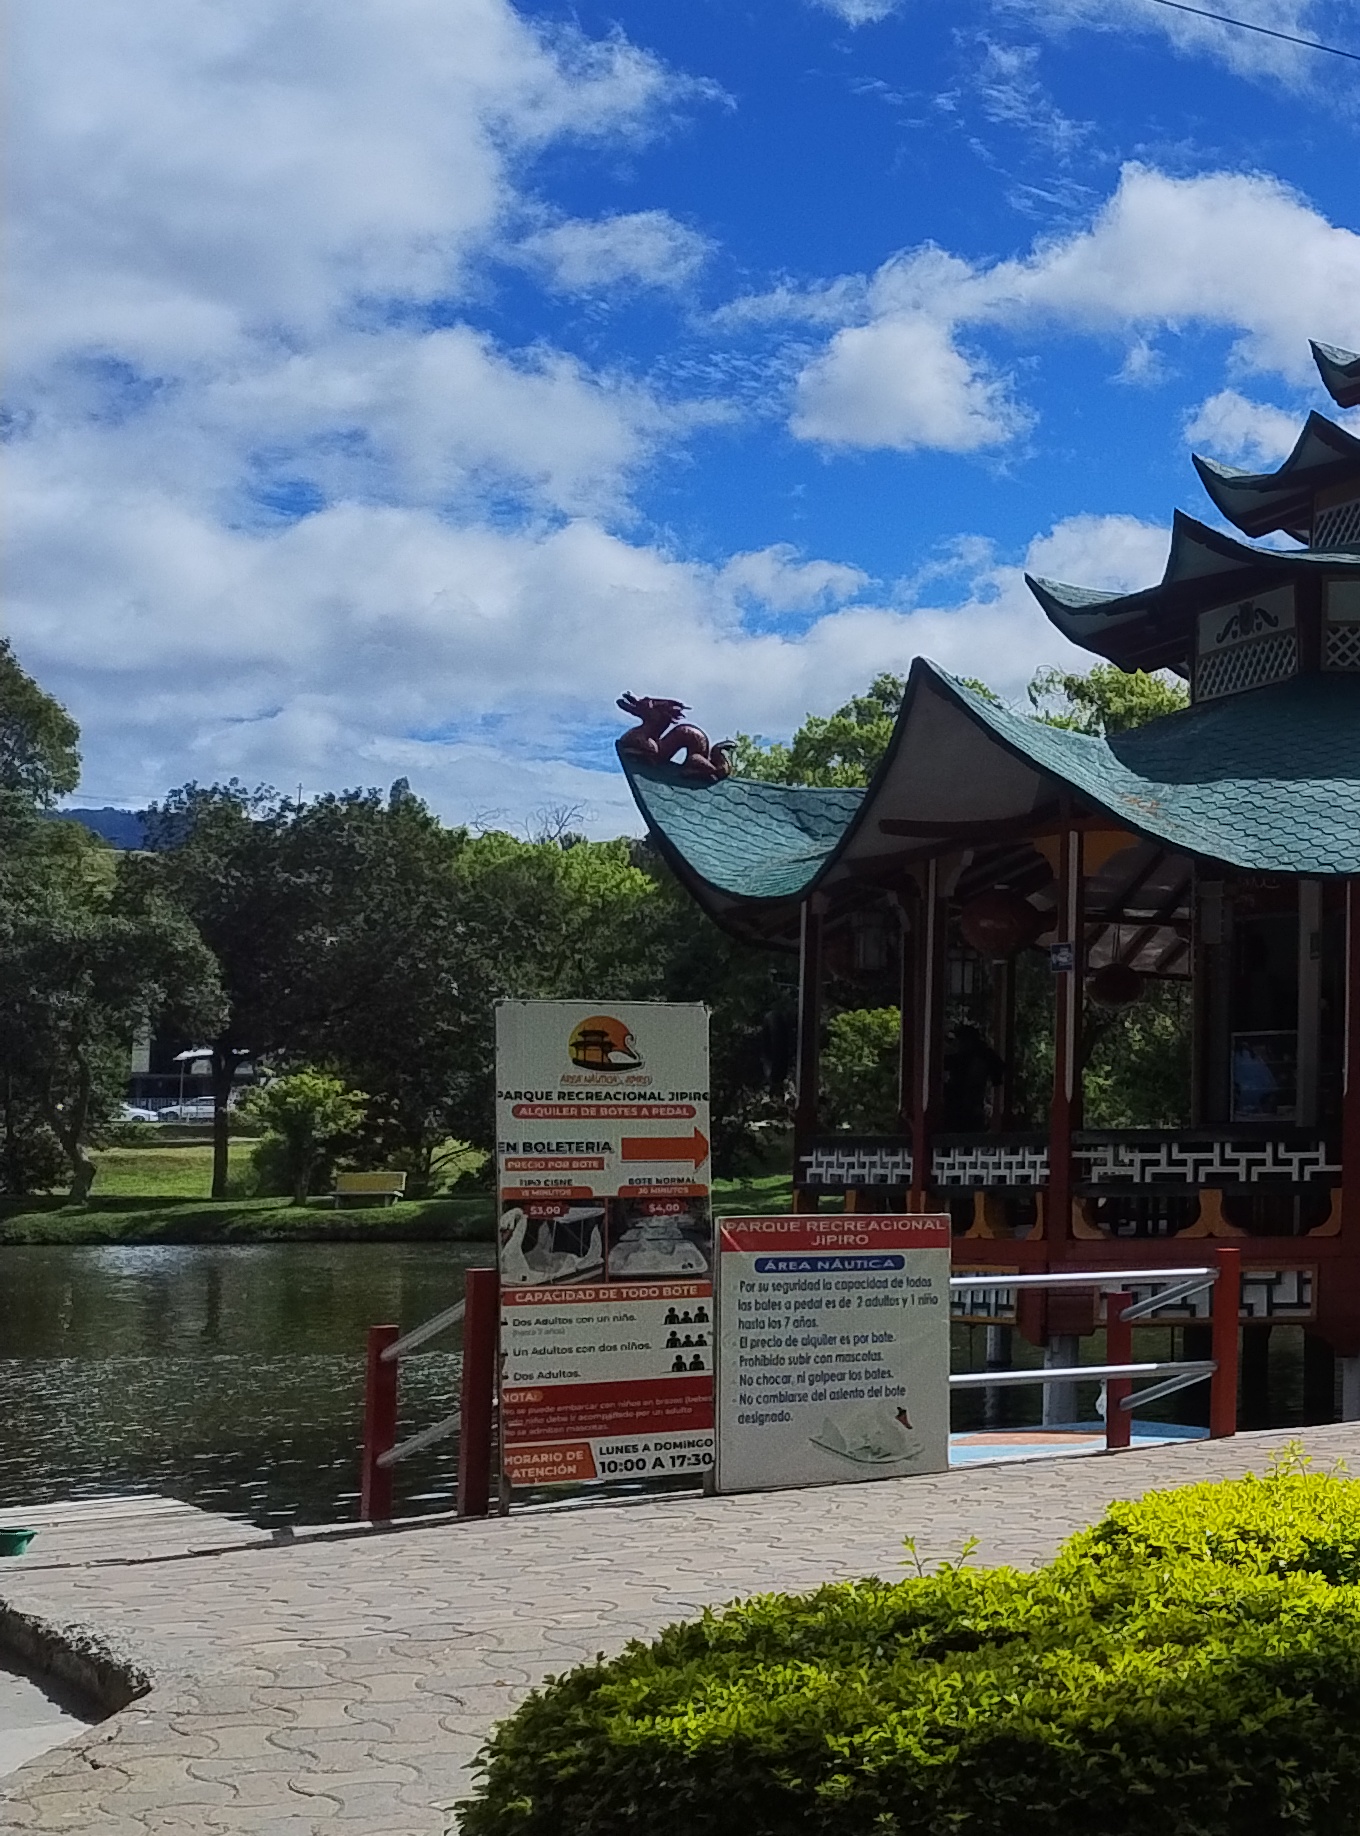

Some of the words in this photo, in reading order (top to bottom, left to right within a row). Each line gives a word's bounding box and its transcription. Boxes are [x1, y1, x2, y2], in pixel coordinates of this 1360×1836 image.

[557, 1091, 664, 1101] RECREACIONAL
[519, 1107, 578, 1117] ALQUILER
[580, 1107, 597, 1116] DE
[600, 1107, 637, 1116] BOTES
[640, 1107, 650, 1116] A
[652, 1106, 689, 1115] PEDAL
[498, 1141, 517, 1152] EN
[522, 1141, 613, 1153] BOLETERIA
[508, 1160, 544, 1169] PRECIO
[548, 1160, 570, 1169] POR
[572, 1160, 599, 1168] BOTE
[726, 1221, 801, 1233] PARQUE
[807, 1220, 946, 1231] RECREACIONAL
[764, 1259, 809, 1270] ÁREA
[818, 1258, 895, 1270] NÁUTICA
[740, 1280, 756, 1292] Por
[758, 1282, 769, 1292] su
[772, 1279, 821, 1294] seguridad
[823, 1280, 832, 1290] la
[835, 1277, 888, 1292] capacidad
[891, 1277, 903, 1289] de
[906, 1277, 932, 1288] todos
[515, 1289, 595, 1303] CAPACIDAD
[599, 1289, 617, 1299] DE
[622, 1287, 659, 1298] TODO
[663, 1285, 698, 1296] BOTE
[738, 1300, 753, 1310] los
[785, 1302, 791, 1310] a
[794, 1297, 823, 1312] pedal
[825, 1300, 836, 1309] es
[839, 1297, 852, 1308] de
[857, 1297, 862, 1308] 2
[865, 1295, 900, 1307] adultos
[900, 1298, 909, 1308] y
[512, 1318, 532, 1327] Dos
[534, 1316, 573, 1326] Adultos
[576, 1316, 594, 1324] con
[738, 1318, 765, 1330] hasta
[768, 1318, 782, 1329] los
[784, 1317, 790, 1328] 7
[793, 1316, 819, 1328] años.
[740, 1337, 748, 1348] El
[750, 1336, 782, 1349] precio
[785, 1335, 798, 1346] de
[801, 1332, 837, 1349] alquiler
[840, 1335, 851, 1345] es
[853, 1333, 869, 1347] por
[513, 1348, 529, 1357] Un
[531, 1346, 573, 1356] Adultos
[576, 1345, 595, 1354] con
[599, 1343, 618, 1352] dos
[740, 1354, 785, 1367] Prohibido
[788, 1352, 811, 1365] subir
[814, 1352, 833, 1364] con
[514, 1372, 534, 1381] Dos
[537, 1369, 581, 1380] Adultos.
[740, 1374, 754, 1386] No
[797, 1372, 806, 1383] ni
[808, 1369, 847, 1385] golpear
[849, 1369, 863, 1381] los
[740, 1392, 754, 1405] No
[756, 1389, 808, 1404] cambiarse
[811, 1389, 827, 1401] del
[830, 1387, 865, 1400] asiento
[867, 1386, 883, 1398] del
[885, 1385, 906, 1396] bote
[738, 1412, 793, 1425] designado.
[600, 1445, 639, 1455] LUNES
[642, 1443, 651, 1452] A
[504, 1453, 562, 1465] HORARIO
[566, 1451, 584, 1461] DE
[599, 1459, 646, 1474] 10:00
[652, 1457, 665, 1469] A
[671, 1453, 713, 1468] 17:30
[512, 1465, 577, 1478] ATENCIÓN
